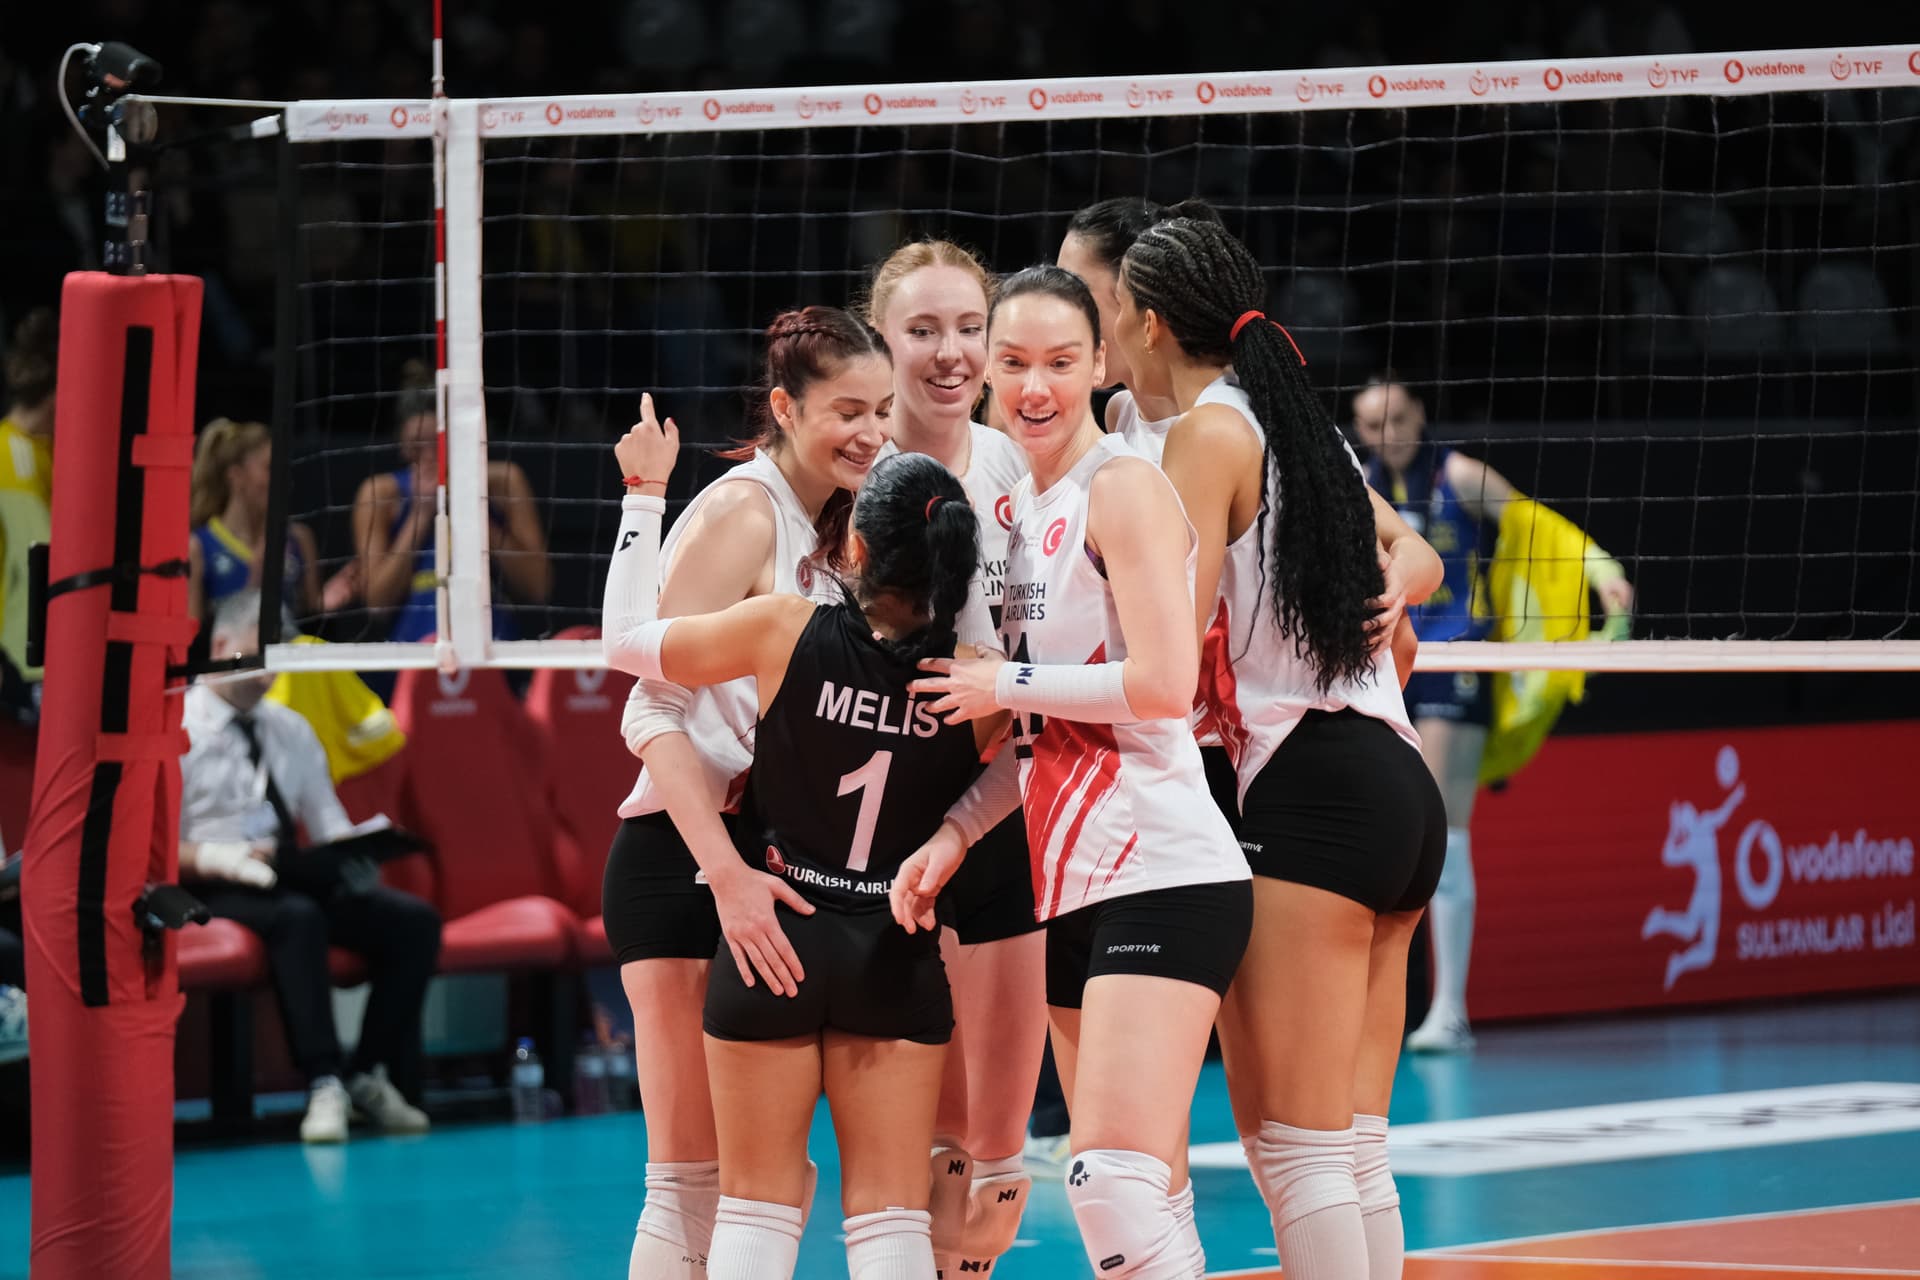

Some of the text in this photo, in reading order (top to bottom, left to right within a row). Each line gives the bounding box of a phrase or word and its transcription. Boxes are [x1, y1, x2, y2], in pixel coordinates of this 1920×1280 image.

[1746, 61, 1806, 78] vodafone
[1853, 60, 1884, 75] TVF
[1491, 76, 1520, 89] TVF
[1565, 69, 1624, 85] vodafone
[1669, 68, 1700, 83] TVF
[1218, 84, 1273, 98] vodafone
[1317, 82, 1344, 96] TVF
[1389, 77, 1446, 91] vodafone
[979, 96, 1006, 108] TVF
[1051, 91, 1104, 104] vodafone
[1147, 89, 1174, 102] TVF
[723, 102, 775, 115] vodafone
[816, 100, 843, 112] TVF
[885, 97, 937, 110] vodafone
[344, 113, 369, 125] TVF
[501, 111, 525, 123] TVF
[566, 107, 616, 120] vodafone
[656, 106, 682, 118] TVF
[1008, 582, 1046, 601] TURKISH
[1005, 603, 1046, 622] AIRLINES
[836, 749, 893, 872] 1
[1787, 829, 1913, 882] vodafone
[785, 864, 852, 890] TURKISH
[1737, 914, 1864, 959] SULTANLAR
[1106, 943, 1161, 954] SPORTIVE
